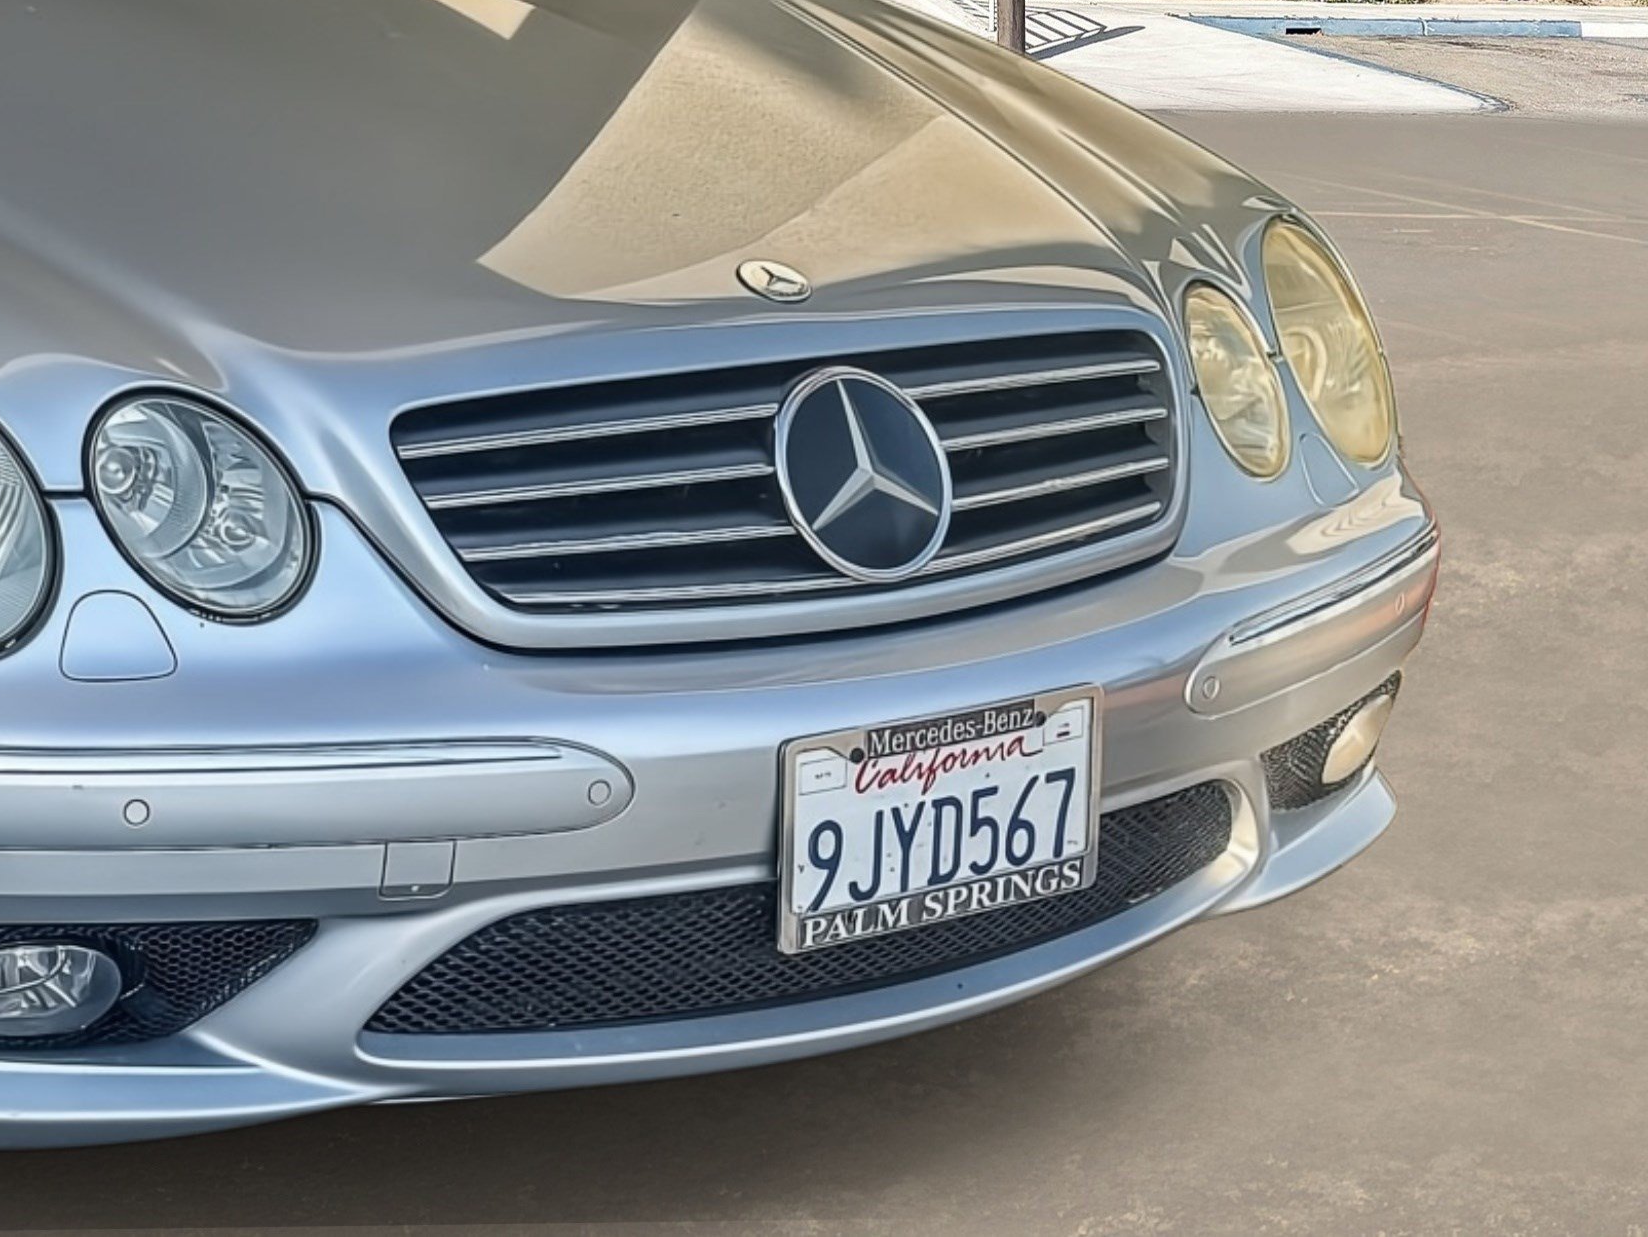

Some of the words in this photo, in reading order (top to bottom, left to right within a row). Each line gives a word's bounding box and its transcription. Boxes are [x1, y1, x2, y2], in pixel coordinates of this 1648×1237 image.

[855, 735, 1043, 795] California
[869, 708, 1033, 757] Mercedes-Benz
[807, 767, 1075, 913] 9JYD567
[803, 901, 908, 948] PALM
[922, 860, 1082, 921] SPRINGS
